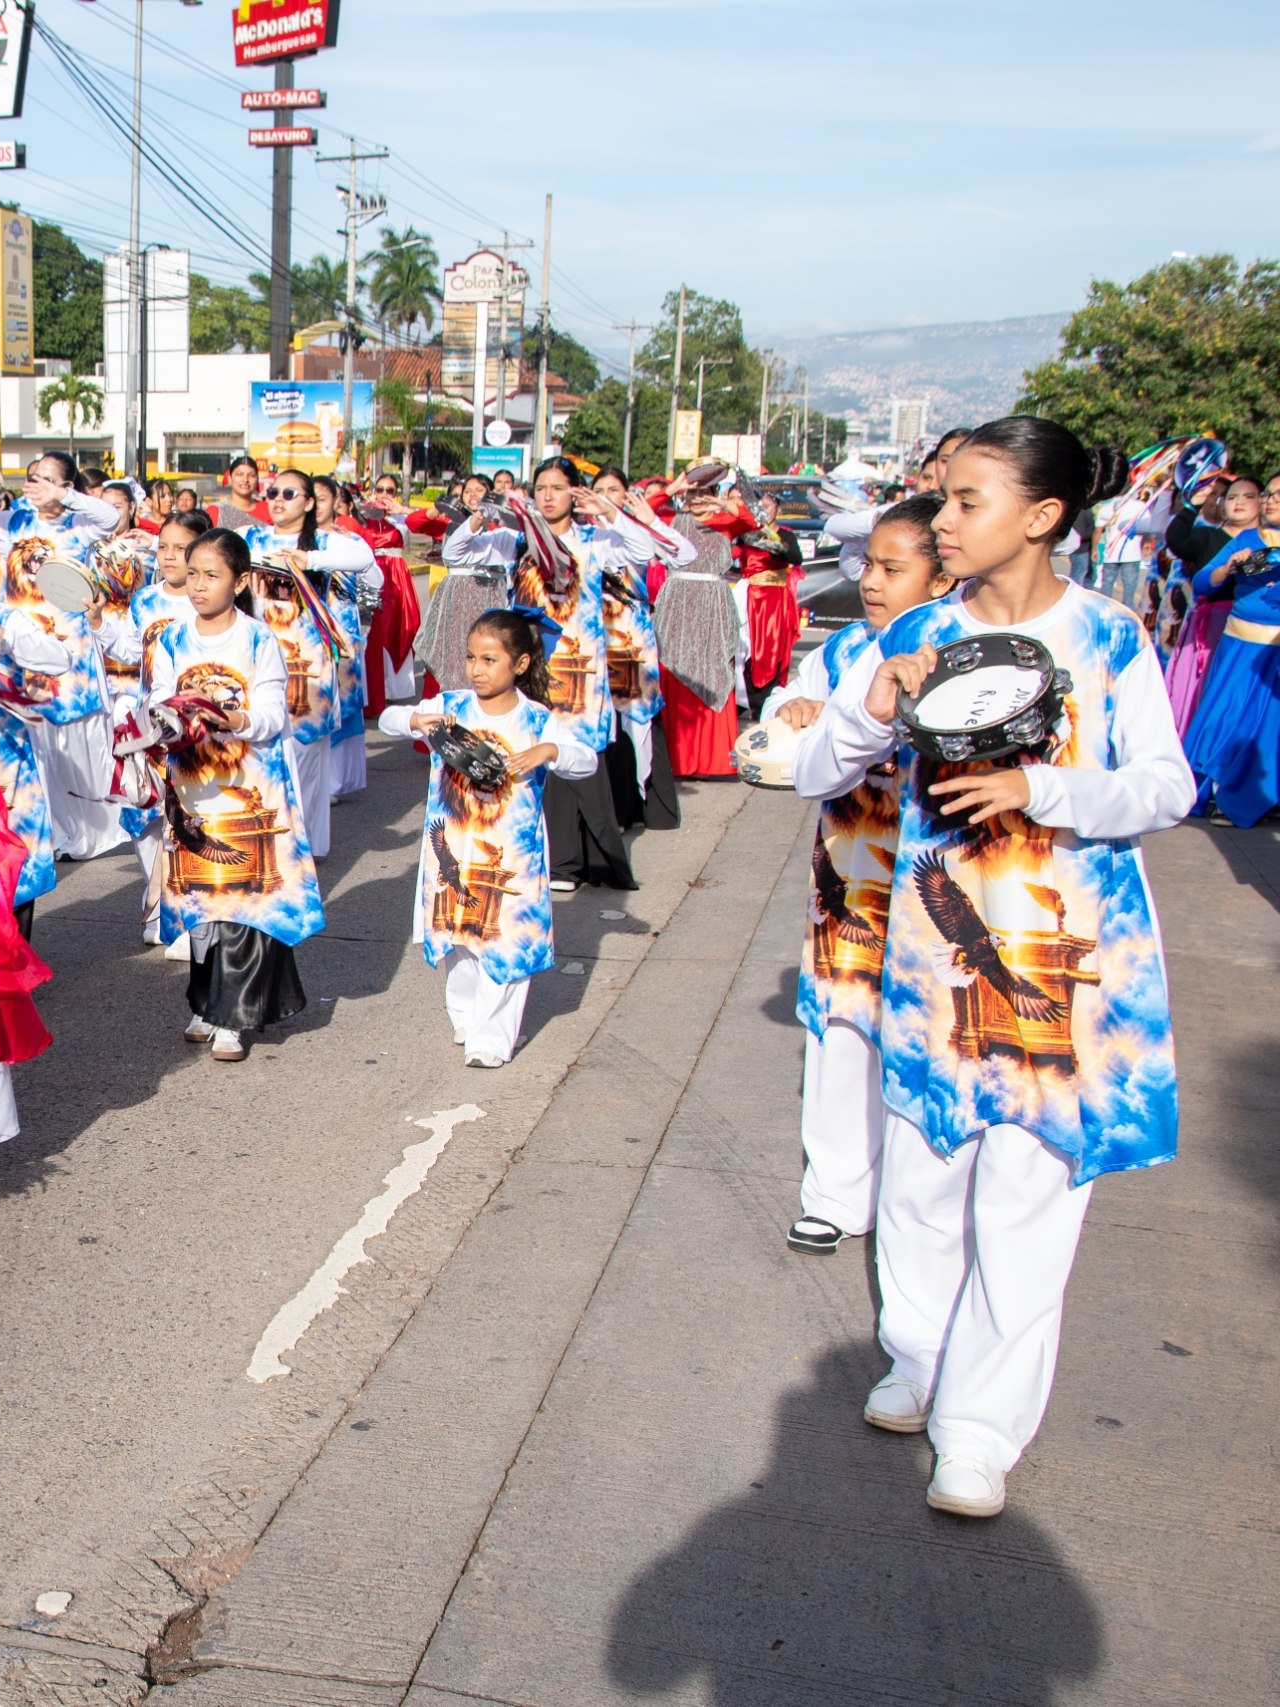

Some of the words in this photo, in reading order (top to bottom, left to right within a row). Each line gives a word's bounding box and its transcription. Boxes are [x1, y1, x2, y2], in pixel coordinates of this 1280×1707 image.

[235, 7, 323, 45] McDonald's
[243, 32, 318, 59] Hamburguesas
[250, 129, 309, 143] DESAYUNO
